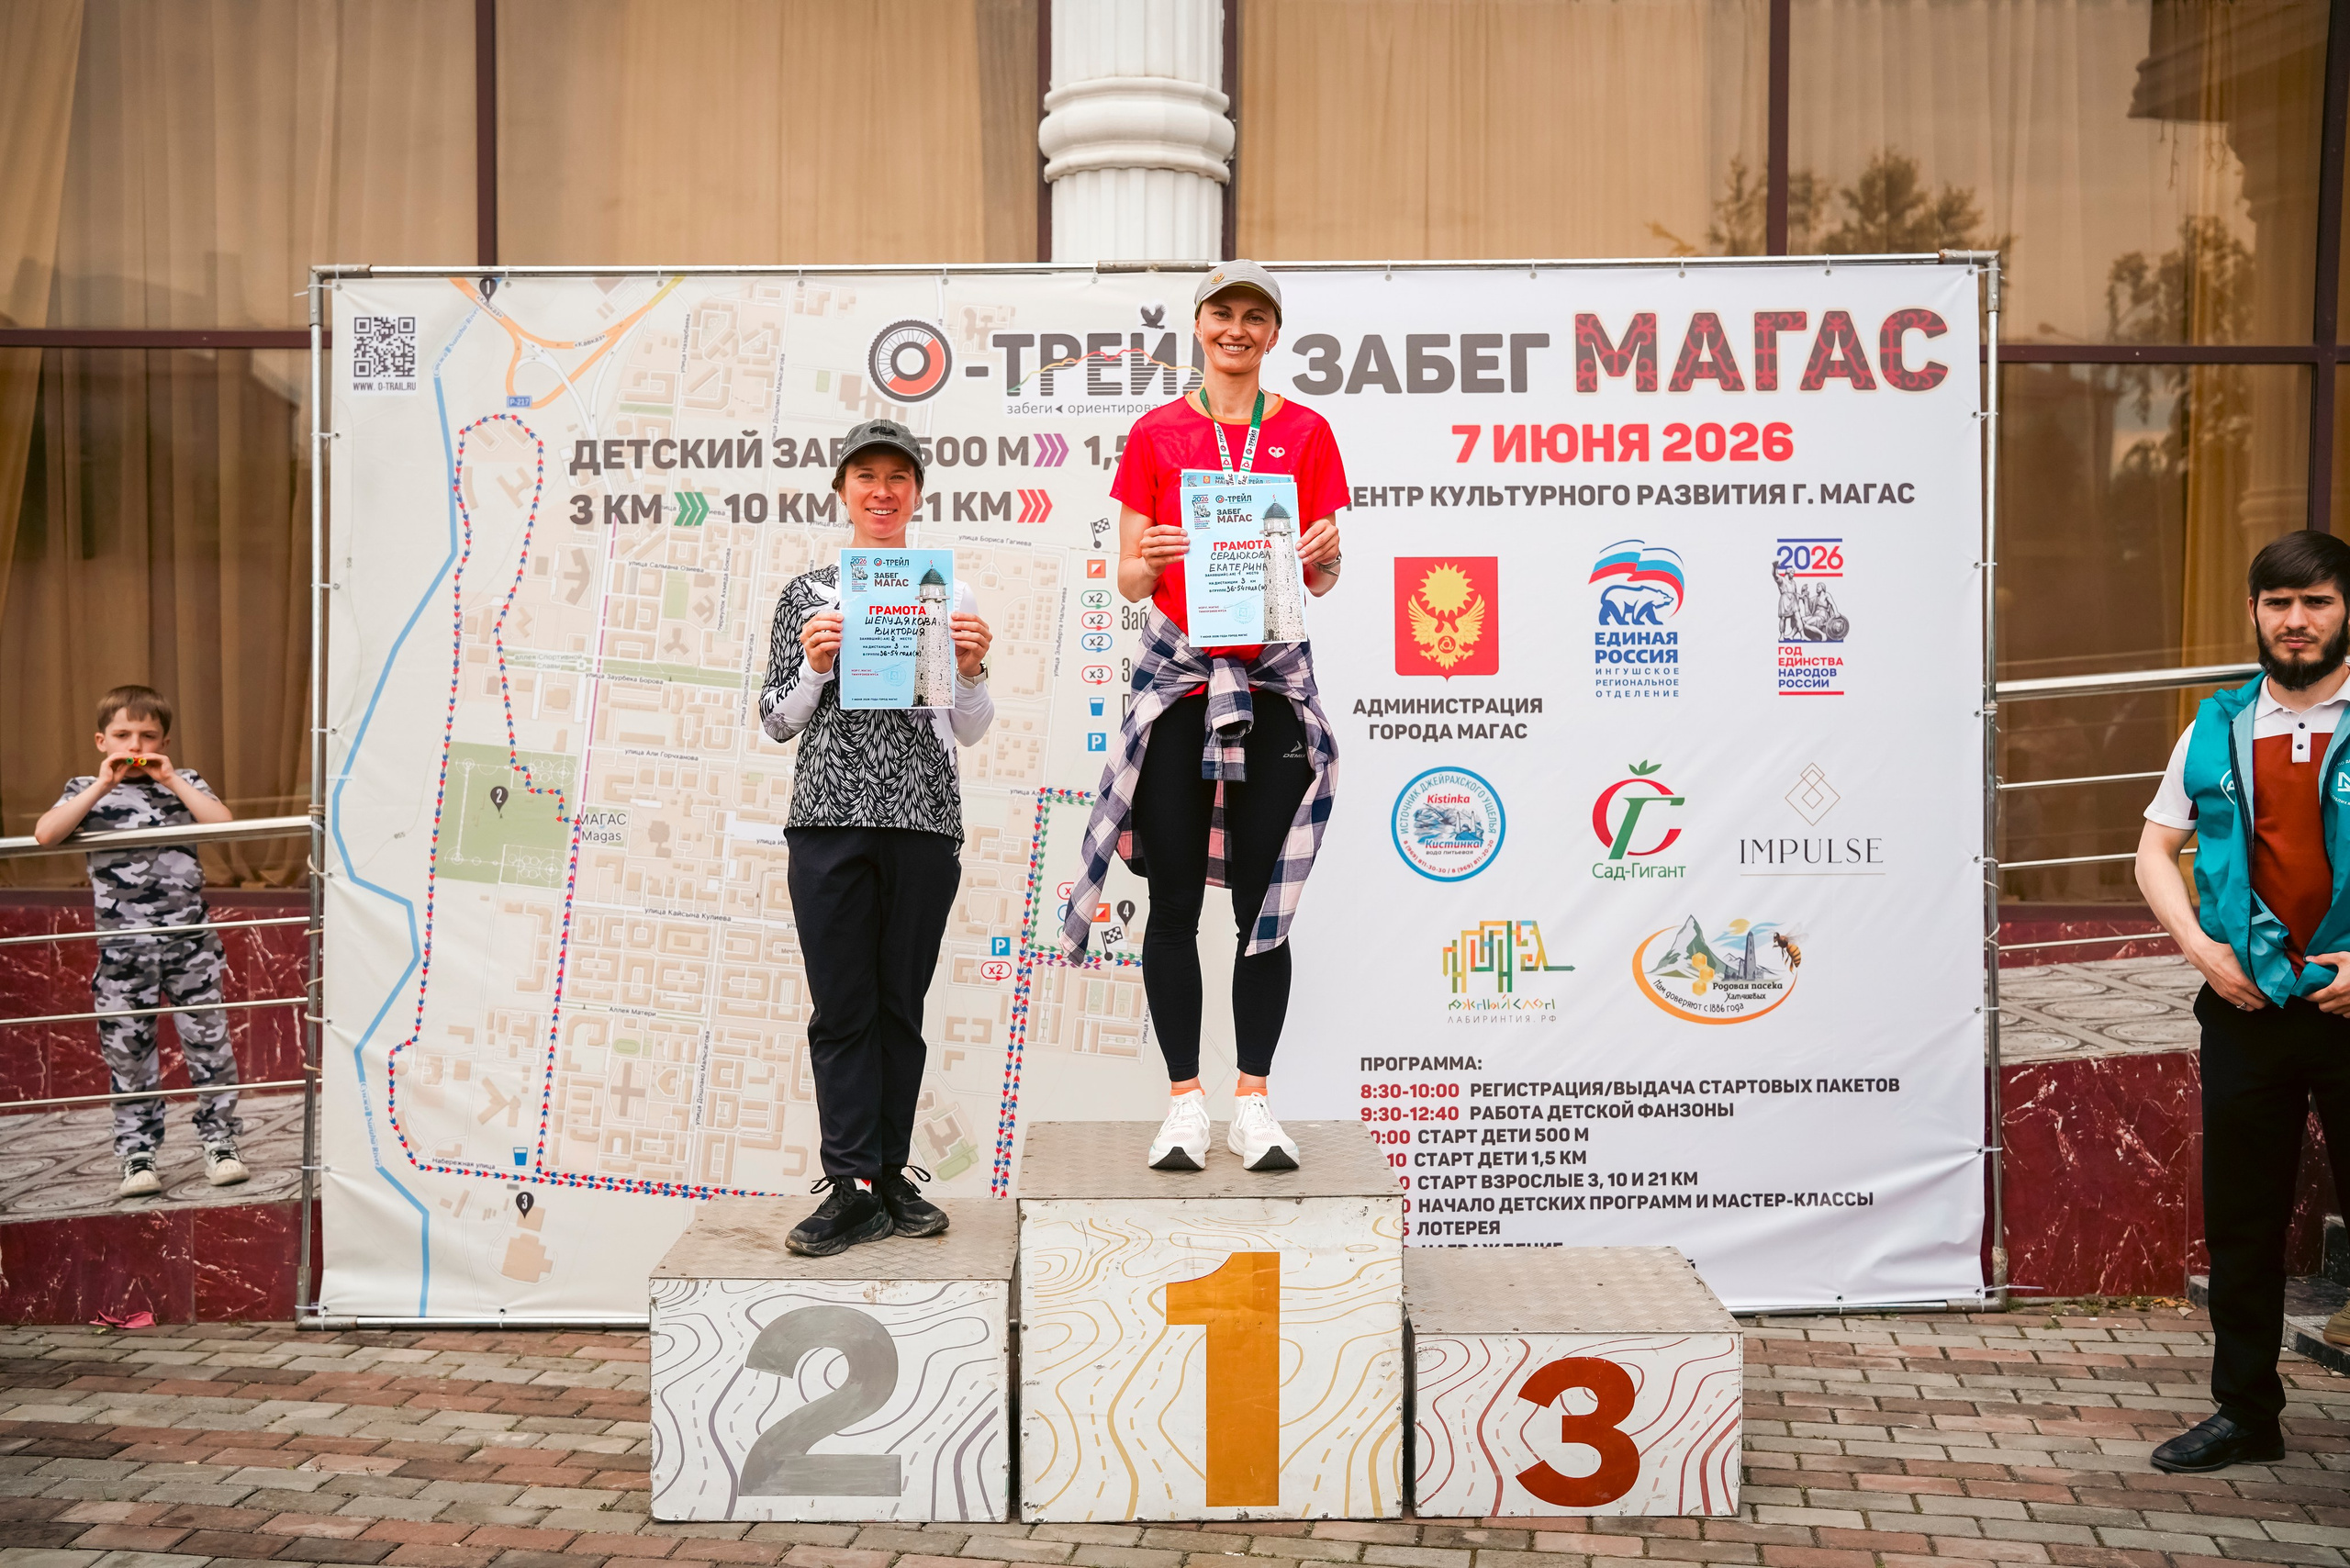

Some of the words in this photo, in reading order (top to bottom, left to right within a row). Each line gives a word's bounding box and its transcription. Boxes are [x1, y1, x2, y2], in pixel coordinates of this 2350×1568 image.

[575, 333, 606, 348] «Кавказ»
[1291, 332, 1550, 396] ЗАБЕГ
[1573, 308, 1951, 394] МАГАС
[1006, 401, 1053, 415] забеги
[1450, 423, 1482, 463] 7
[1493, 422, 1651, 463] ИЮНЯ
[1662, 421, 1796, 463] 2026
[569, 429, 763, 476] ДЕТСКИЙ
[998, 435, 1029, 466] М
[1430, 484, 1631, 507] КУЛЬТУРНОГО
[1638, 483, 1785, 506] РАЗВИТИЯ
[1793, 483, 1815, 505] Г.
[1821, 482, 1916, 506] МАГАС
[569, 494, 594, 525] 3
[603, 494, 663, 525] КМ
[723, 493, 768, 524] 10
[778, 493, 836, 523] КМ
[953, 490, 1012, 522] КМ
[1217, 514, 1253, 523] МАГАС
[958, 534, 979, 543] улица
[979, 535, 1005, 544] Бориса
[1006, 539, 1032, 547] Гагиева
[1213, 540, 1272, 551] ГРАМОТА
[1210, 551, 1271, 561] СЕРДЮКОВА
[1776, 545, 1844, 570] 2026
[628, 560, 648, 569] улица
[649, 562, 678, 571] Салмана
[680, 565, 705, 574] Озиева
[1209, 562, 1269, 572] ЕКАТЕРИНА
[874, 578, 910, 587] МАГАС
[1088, 593, 1103, 604] x2
[868, 606, 927, 615] ГРАМОТА
[865, 615, 937, 625] ШЕЛУДЯКОВА
[1089, 614, 1104, 625] x2
[874, 627, 925, 636] ВИКТОРИЯ
[1089, 635, 1104, 646] x2
[1595, 632, 1678, 646] ЕДИНАЯ
[1595, 648, 1678, 664] РОССИЯ
[1777, 646, 1802, 656] ГОД
[1777, 657, 1844, 667] ЕДИНСТВА
[585, 671, 605, 680] улица
[607, 672, 638, 683] Заурбека
[639, 675, 664, 685] Борова
[1089, 667, 1104, 679] x3
[1595, 667, 1679, 676] ИНГУШСКОЕ
[1777, 668, 1838, 678] НАРОДОВ
[1595, 678, 1679, 687] РЕГИОНАЛЬНОЕ
[1777, 678, 1830, 689] РОССИИ
[1595, 689, 1679, 699] ОТДЕЛЕНИЕ
[1352, 697, 1543, 718] АДМИНИСТРАЦИЯ
[1369, 723, 1453, 743] ГОРОДА
[1458, 722, 1528, 740] МАГАС
[624, 747, 644, 756] улица
[646, 748, 659, 757] Али
[660, 751, 699, 762] Горчханова
[496, 788, 503, 804] 2
[1427, 793, 1471, 804] Kistinka
[1400, 789, 1421, 834] ИСТОЧНИК
[1420, 773, 1486, 799] ДЖЕЙРАХСКОГО
[1482, 796, 1497, 834] УЩЕЛЬЯ
[578, 812, 628, 826] МАГАС
[581, 830, 622, 844] Magas
[755, 837, 777, 846] улица
[1425, 839, 1480, 849] Кистинка
[1740, 837, 1885, 864] IMPULSE
[1591, 862, 1686, 880] Сад-Гигант
[644, 907, 666, 916] улица
[667, 908, 700, 920] Кайсына
[701, 913, 732, 923] Кулиева
[1123, 902, 1129, 918] 4
[988, 964, 1003, 975] x2
[1712, 982, 1749, 991] Родовая
[1751, 981, 1783, 991] пасека
[1652, 979, 1666, 995] Нам
[1665, 991, 1702, 1011] доверяют
[1704, 1004, 1708, 1013] с
[1709, 1003, 1725, 1013] 1886
[1726, 1002, 1744, 1014] года
[609, 1006, 630, 1014] Аллея
[631, 1008, 656, 1018] Матери
[1360, 1056, 1483, 1071] ПРОГРАММА:
[1360, 1083, 1460, 1099] 8:30-10:00
[1470, 1081, 1695, 1098] РЕГИСТРАЦИЯ/ВЫДАЧА
[1698, 1079, 1813, 1094] СТАРТОВЫХ
[1816, 1078, 1900, 1093] ПАКЕТОВ
[1360, 1106, 1460, 1122] 9:30-12:40
[1470, 1104, 1544, 1121] РАБОТА
[1547, 1100, 1634, 1122] ДЕТСКОЙ
[1637, 1102, 1734, 1118] ФАНЗОНЫ
[1417, 1128, 1478, 1144] СТАРТ
[1481, 1128, 1531, 1146] ДЕТИ
[1535, 1127, 1570, 1143] 500
[1573, 1126, 1589, 1142] М
[431, 1157, 470, 1169] Набережная
[471, 1160, 496, 1170] улица
[1414, 1152, 1474, 1168] СТАРТ
[1477, 1151, 1528, 1169] ДЕТИ
[1530, 1150, 1556, 1168] 1,5
[1560, 1150, 1587, 1165] КМ
[1417, 1174, 1478, 1191] СТАРТ
[1481, 1173, 1584, 1190] ВЗРОСЛЫЕ
[1587, 1173, 1605, 1190] 3,
[1607, 1172, 1628, 1187] 10
[1631, 1171, 1644, 1187] И
[1648, 1171, 1667, 1186] 21
[1672, 1171, 1698, 1186] КМ
[520, 1193, 529, 1210] 3
[1418, 1197, 1495, 1213] НАЧАЛО
[1498, 1195, 1586, 1215] ДЕТСКИХ
[1589, 1194, 1692, 1210] ПРОГРАММ
[1696, 1194, 1708, 1208] И
[1712, 1192, 1874, 1208] МАСТЕР-КЛАССЫ
[1416, 1220, 1501, 1237] ЛОТЕРЕЯ
[1166, 1251, 1281, 1506] 1
[737, 1305, 902, 1497] 2
[1516, 1357, 1640, 1506] 3
